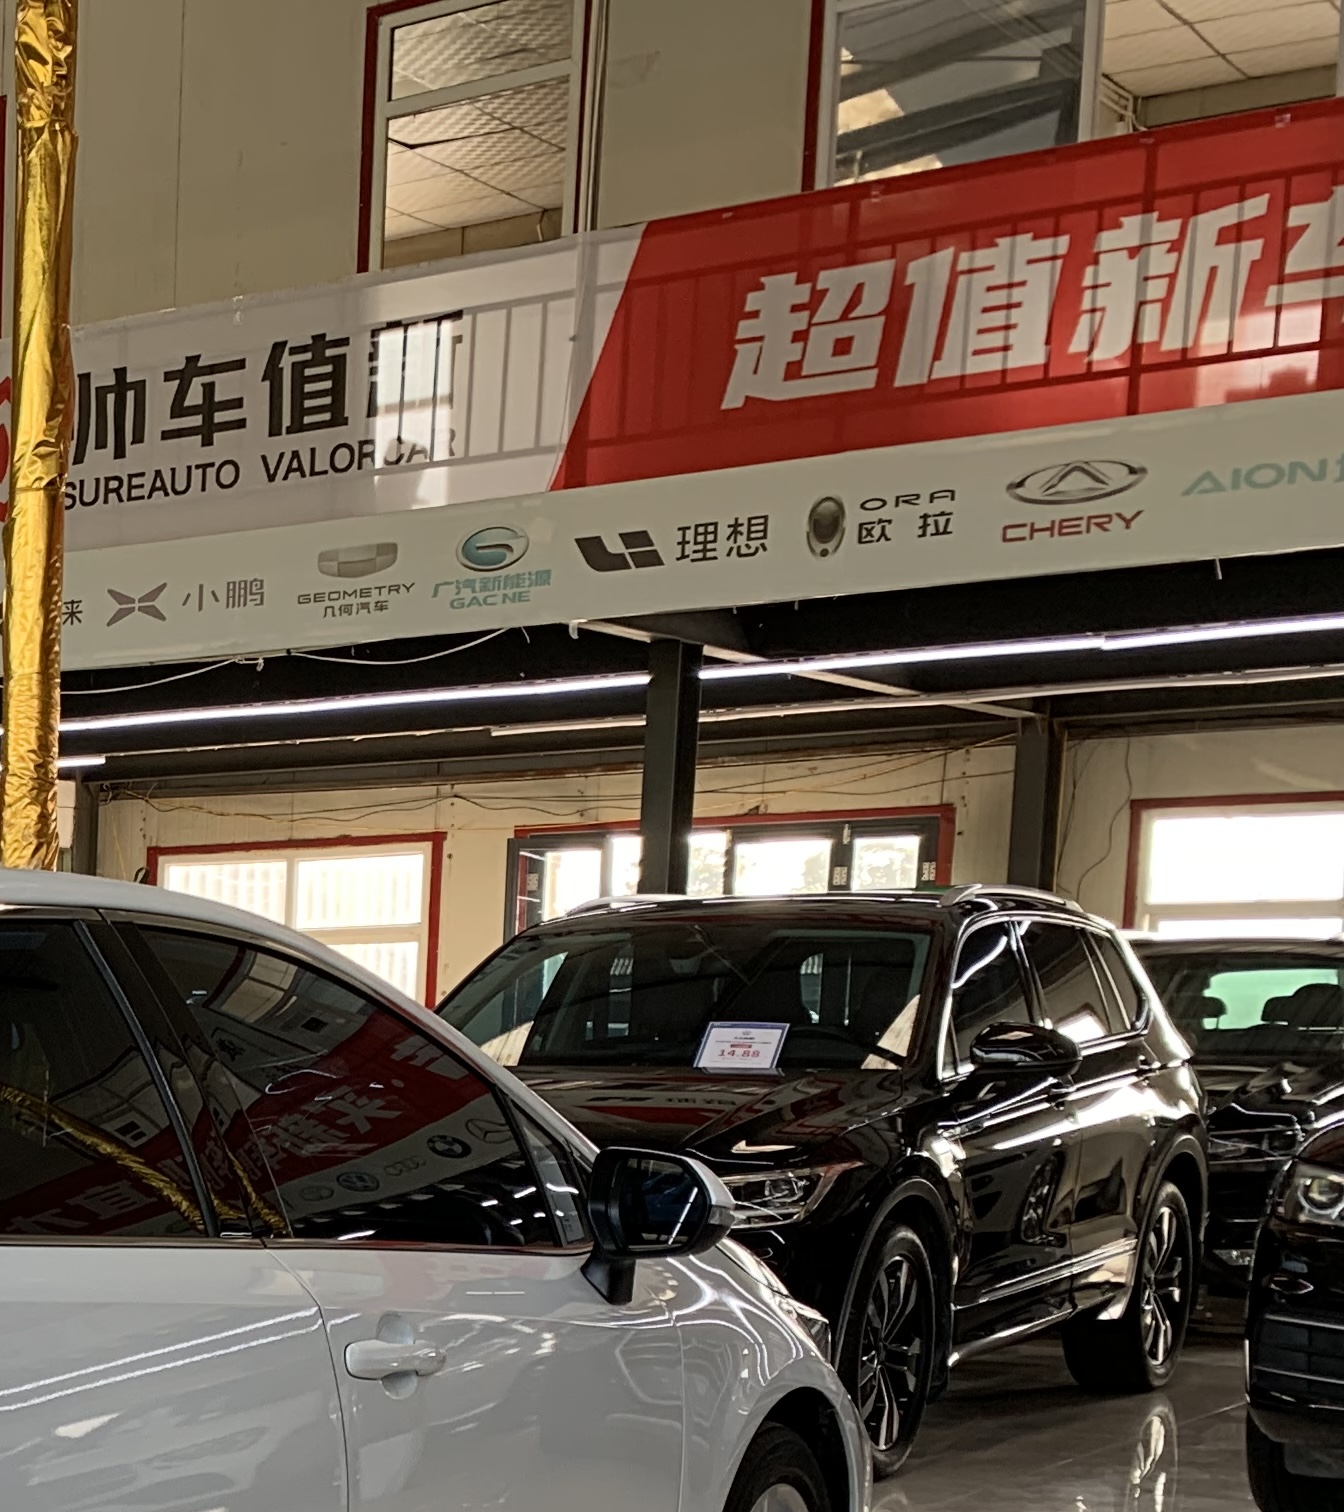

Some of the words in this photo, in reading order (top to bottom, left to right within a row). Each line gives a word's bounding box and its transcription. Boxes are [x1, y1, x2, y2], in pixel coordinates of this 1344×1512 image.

[66, 459, 240, 510] SUREAUTO
[1180, 458, 1328, 497] AION
[860, 489, 955, 511] ORA
[675, 514, 770, 563] 理想
[857, 511, 954, 545] 欧拉
[1002, 510, 1145, 543] CHERY
[182, 578, 265, 613] 小鹏
[297, 582, 415, 605] GEOMETRY
[431, 569, 552, 599] 广汽新能源
[449, 592, 498, 610] GAC
[502, 590, 531, 604] NE
[323, 600, 389, 619] 几何汽车
